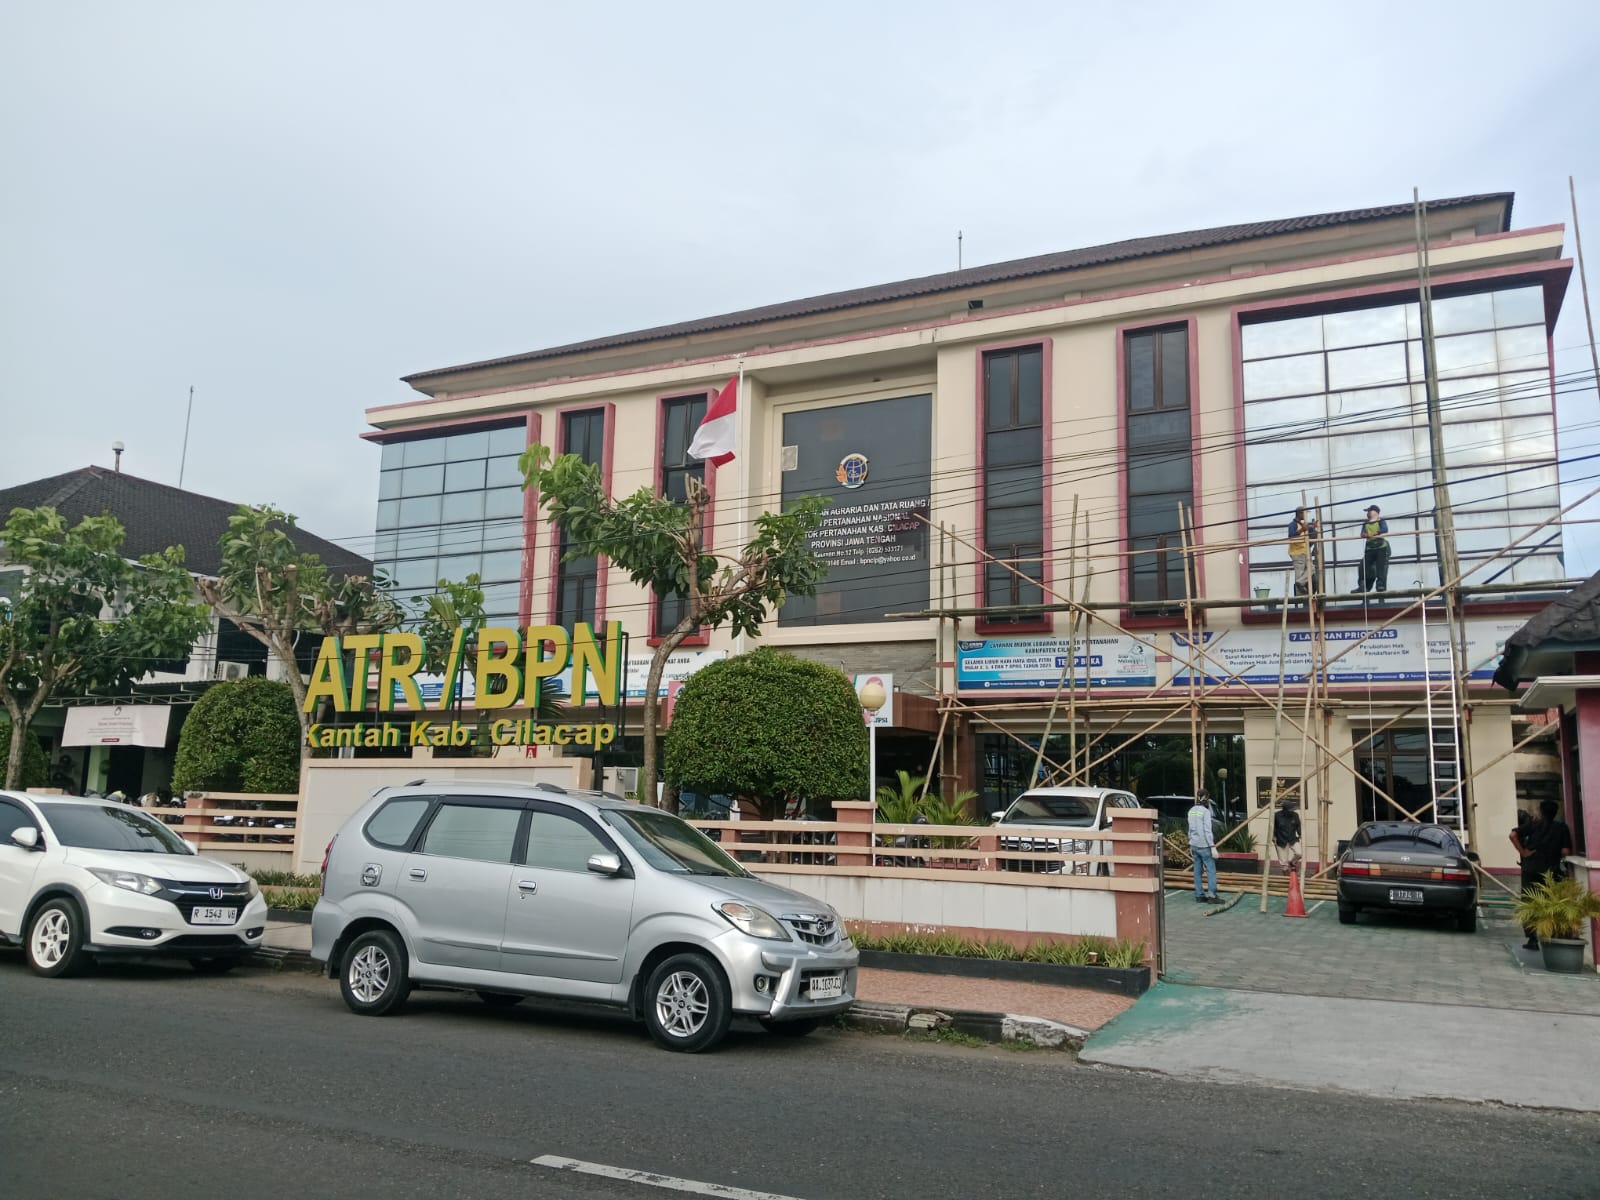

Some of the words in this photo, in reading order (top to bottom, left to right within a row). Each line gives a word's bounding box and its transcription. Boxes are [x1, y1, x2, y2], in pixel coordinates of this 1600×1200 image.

[830, 505, 863, 516] AGRARIA
[863, 503, 879, 513] DAN
[880, 501, 898, 511] TATA
[899, 499, 926, 509] RUANG
[823, 515, 871, 527] PERTANAHAN
[872, 511, 911, 523] NASIONAL
[819, 525, 867, 537] PERTANAHAN
[811, 538, 844, 549] PROVINSI
[844, 537, 865, 546] JAWA
[866, 534, 896, 544] TENGAH
[1344, 629, 1395, 639] PRIOITAS
[1057, 657, 1079, 667] TEP
[308, 721, 401, 747] Kantah
[409, 720, 476, 747] Kab.
[491, 718, 617, 751] Cilacap
[194, 909, 199, 918] R
